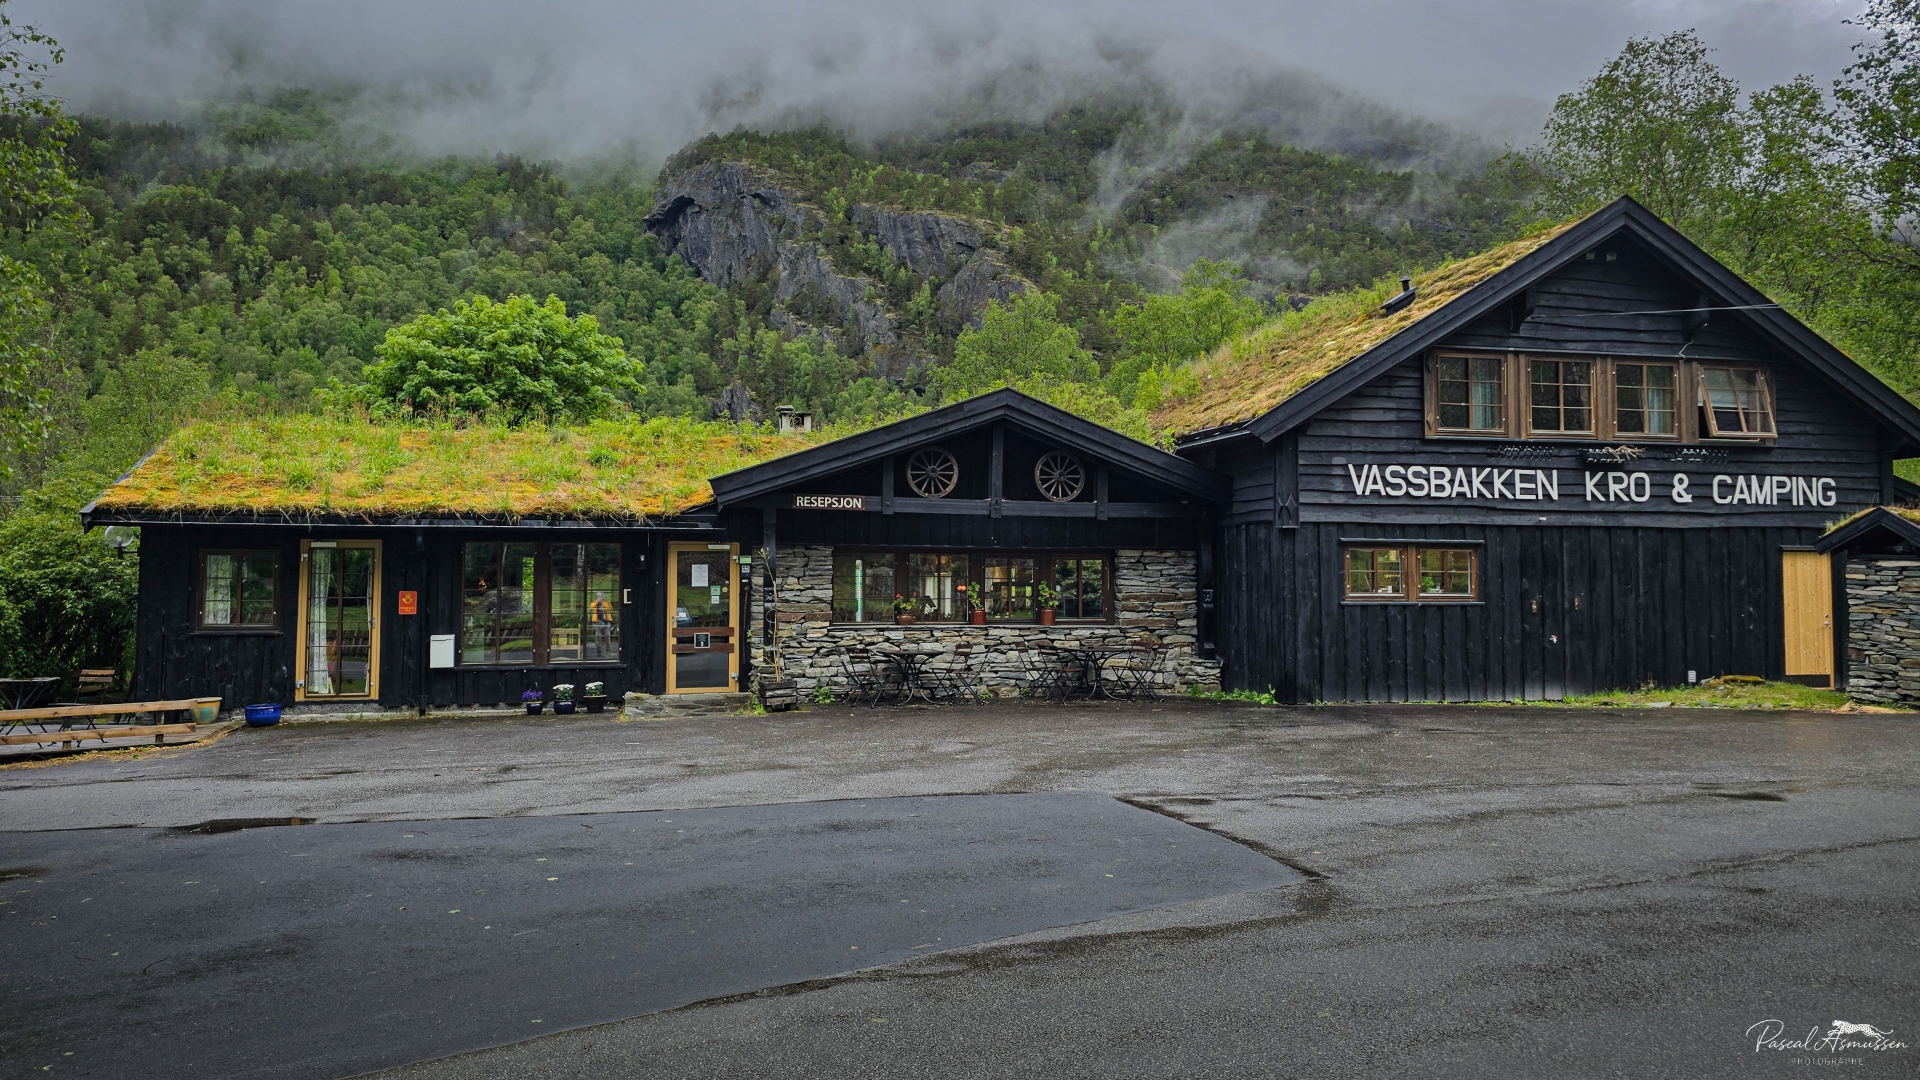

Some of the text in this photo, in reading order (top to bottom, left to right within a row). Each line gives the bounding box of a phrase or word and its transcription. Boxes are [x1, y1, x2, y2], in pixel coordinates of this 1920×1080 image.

[1348, 464, 1836, 506] VASSBAKKEN KRO & CAMPING
[796, 496, 862, 508] RESEPSJON
